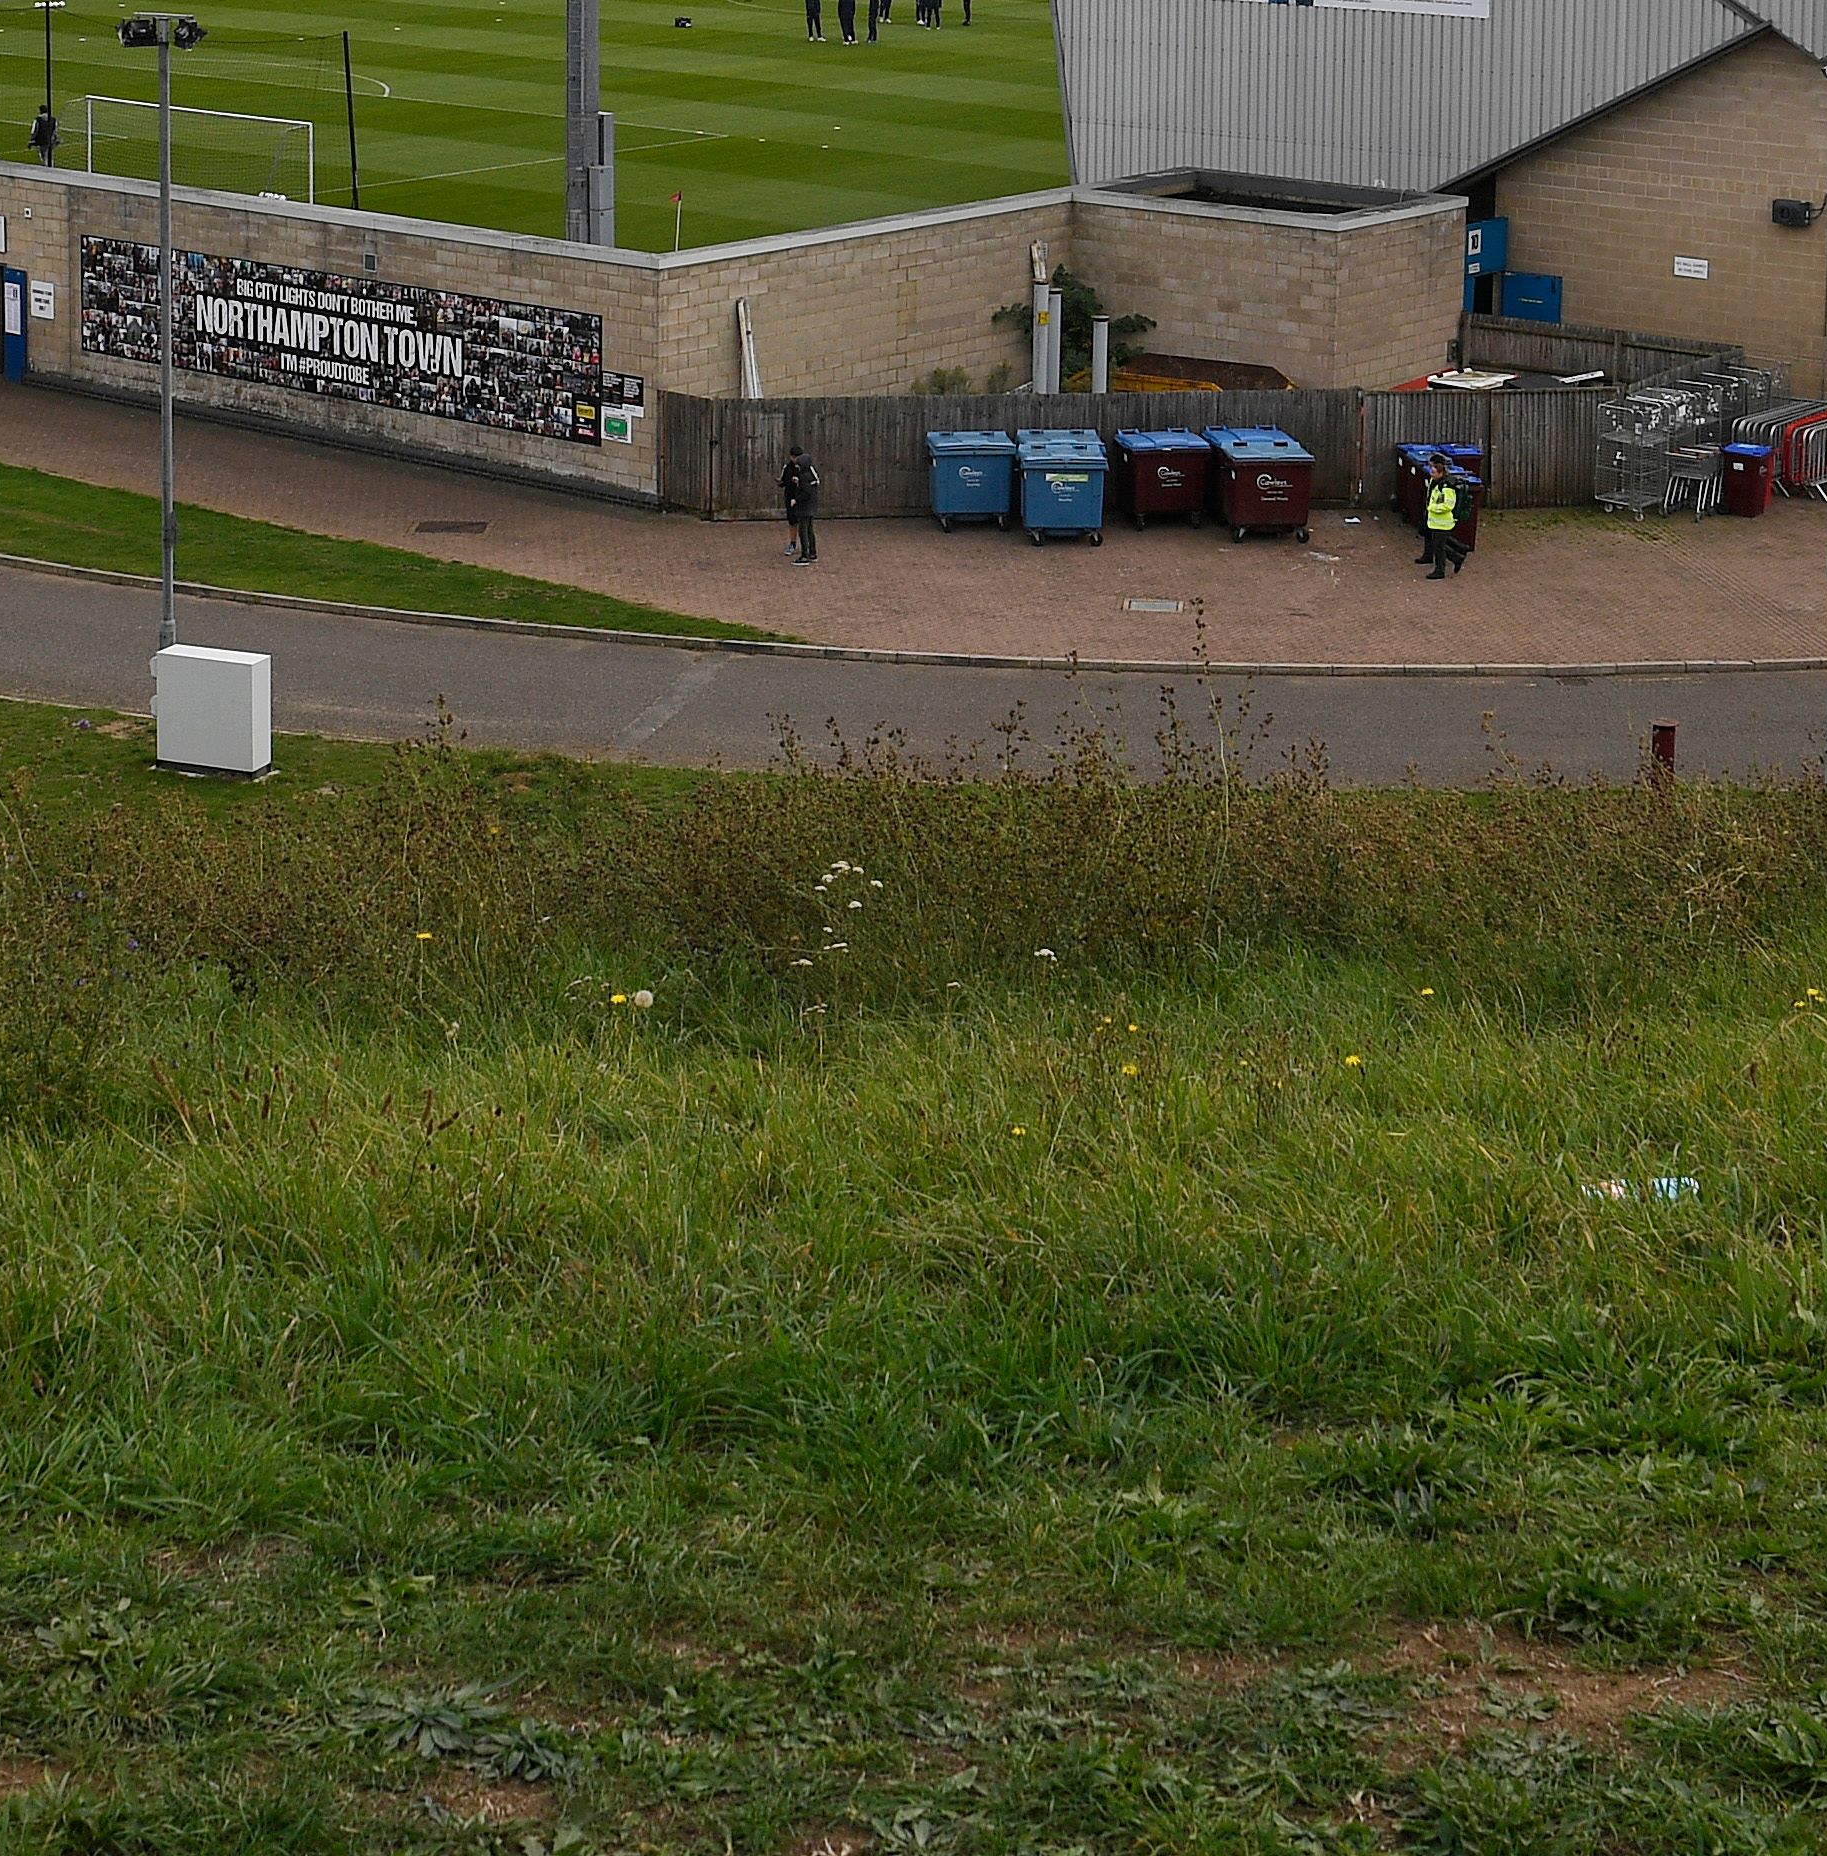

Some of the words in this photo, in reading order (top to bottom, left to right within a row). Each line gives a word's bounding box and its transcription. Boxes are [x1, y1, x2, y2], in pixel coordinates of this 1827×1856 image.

[1471, 224, 1479, 250] 10
[237, 279, 254, 297] BIG
[255, 281, 278, 302] CITY
[280, 286, 316, 308] LIGHTS
[318, 292, 349, 314] DON'T
[351, 297, 394, 321] BOTHER
[396, 305, 418, 327] ME,
[197, 295, 379, 363] NORTHAMPTON
[384, 325, 463, 378] TOWN
[280, 352, 297, 373] I'M
[298, 356, 370, 386] #PROUDTOBE
